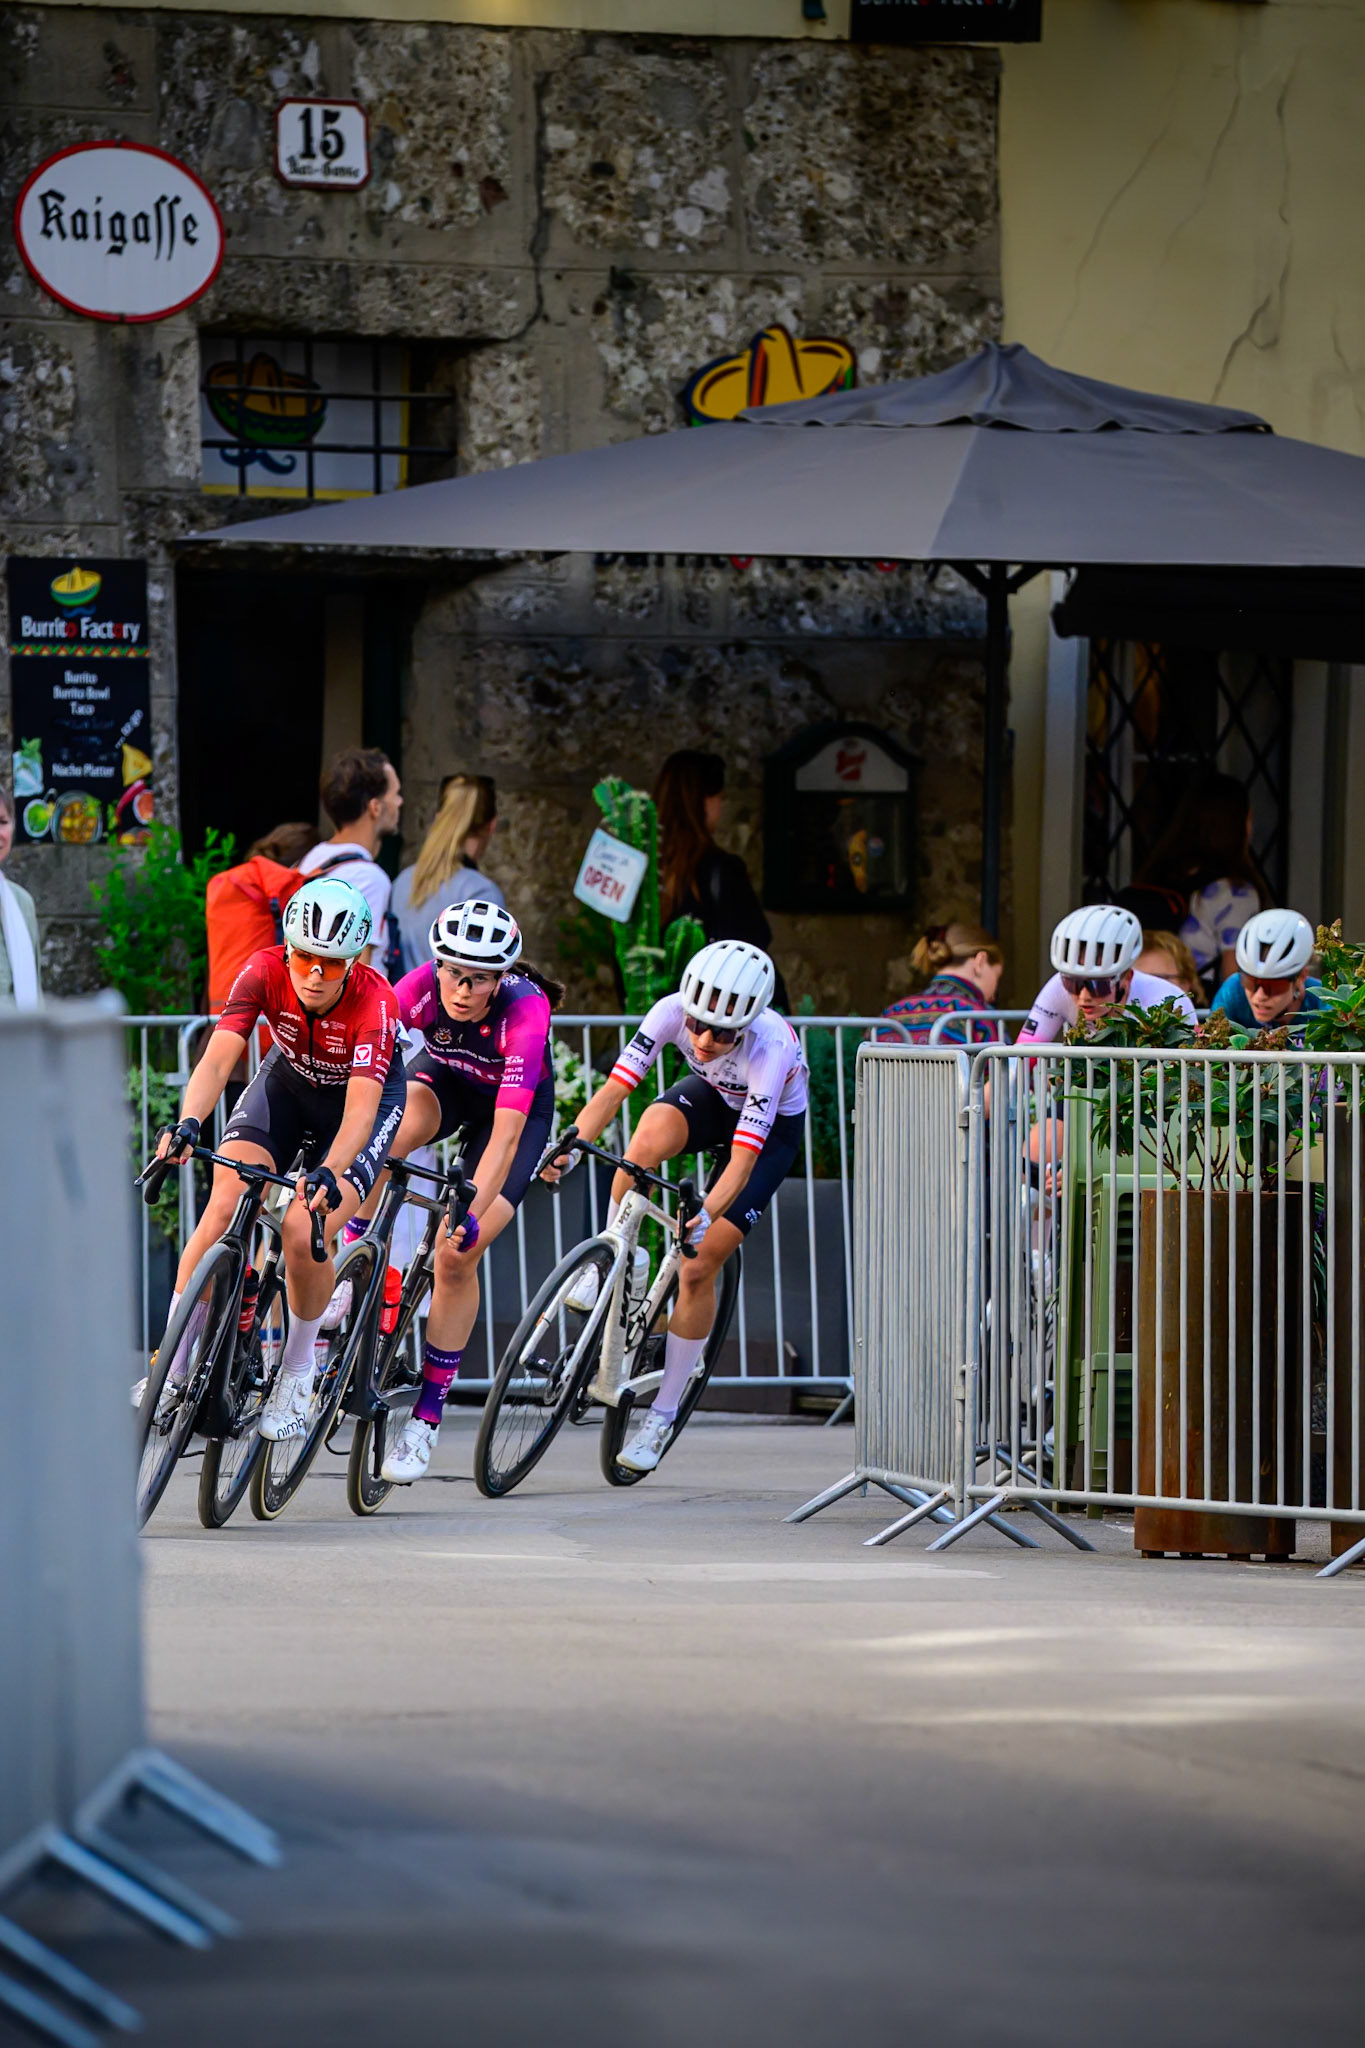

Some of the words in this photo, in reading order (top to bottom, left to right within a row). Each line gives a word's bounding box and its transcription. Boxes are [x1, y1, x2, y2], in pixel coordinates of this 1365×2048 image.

[298, 107, 346, 160] 15
[21, 615, 78, 638] Burrito
[80, 616, 141, 643] Factory
[583, 865, 625, 902] OPEN
[302, 902, 310, 938] LAZER
[337, 911, 356, 947] LAZER
